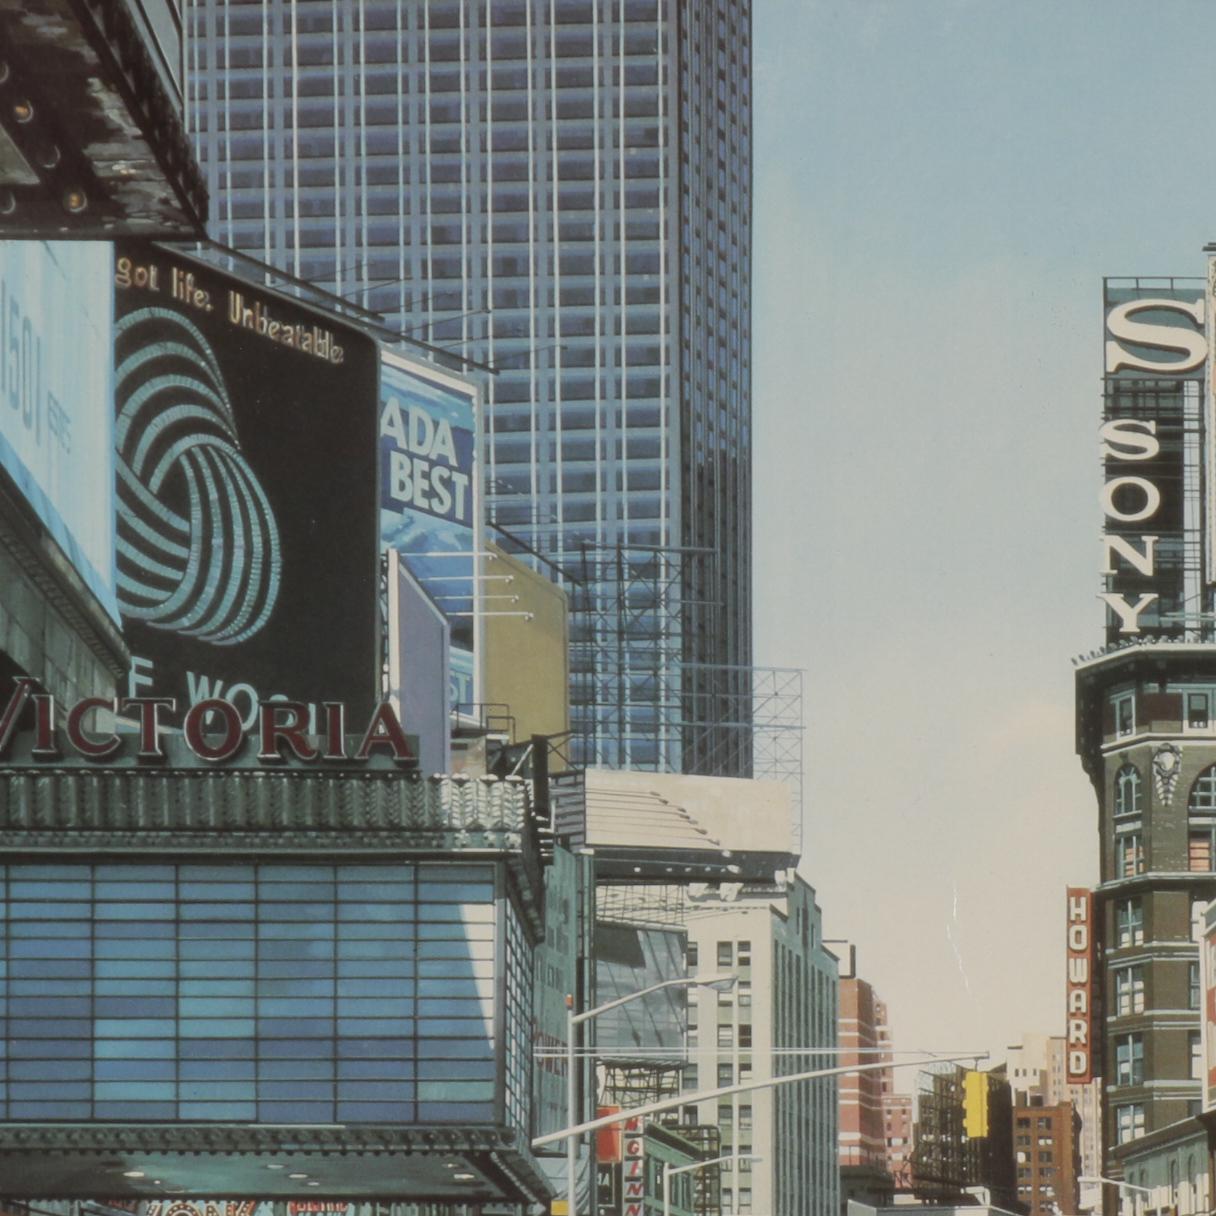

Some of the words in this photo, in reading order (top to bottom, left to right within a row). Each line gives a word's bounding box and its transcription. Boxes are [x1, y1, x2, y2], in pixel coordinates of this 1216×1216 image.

[115, 256, 160, 291] got
[381, 396, 459, 467] ADA
[390, 450, 469, 521] BEST
[1100, 420, 1161, 633] SONY
[1069, 896, 1088, 1075] HOWARD
